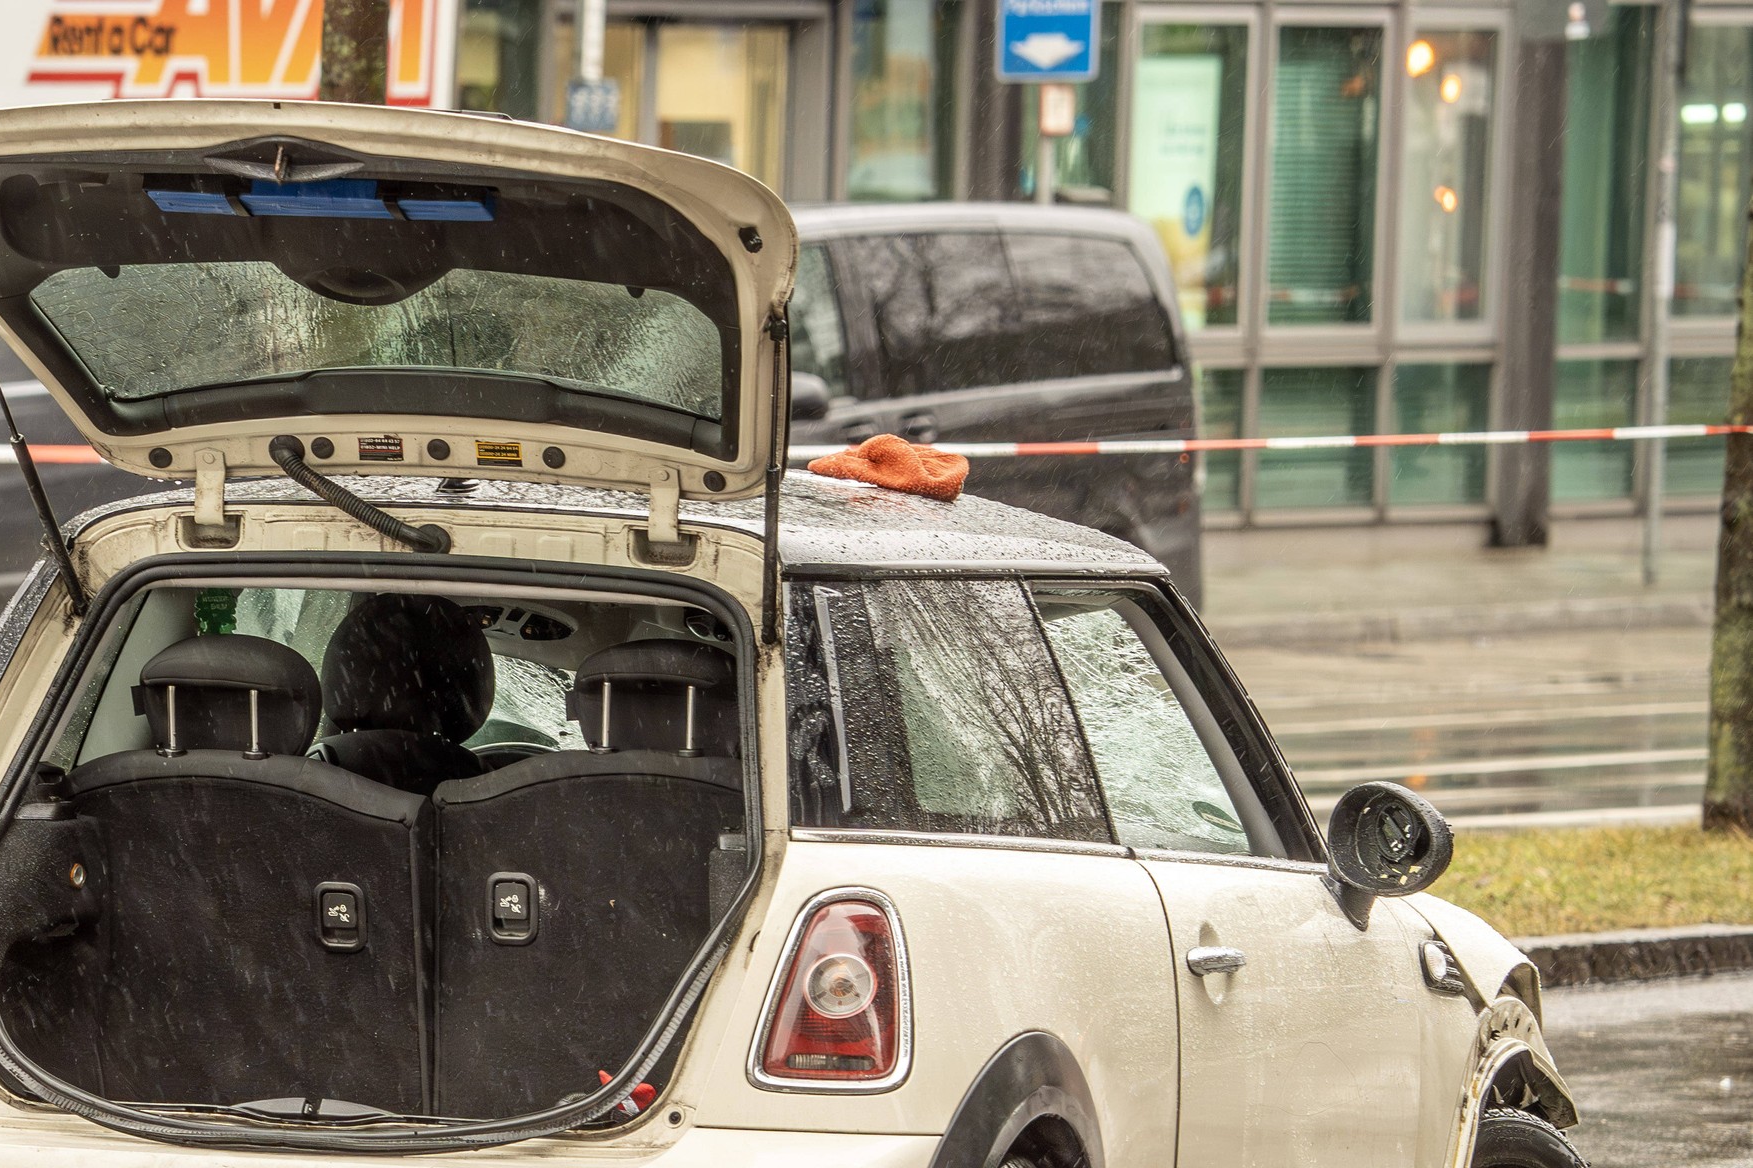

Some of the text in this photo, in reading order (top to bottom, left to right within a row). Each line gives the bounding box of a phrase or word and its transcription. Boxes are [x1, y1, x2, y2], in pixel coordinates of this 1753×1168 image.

[50, 15, 176, 57] Rent a Car
